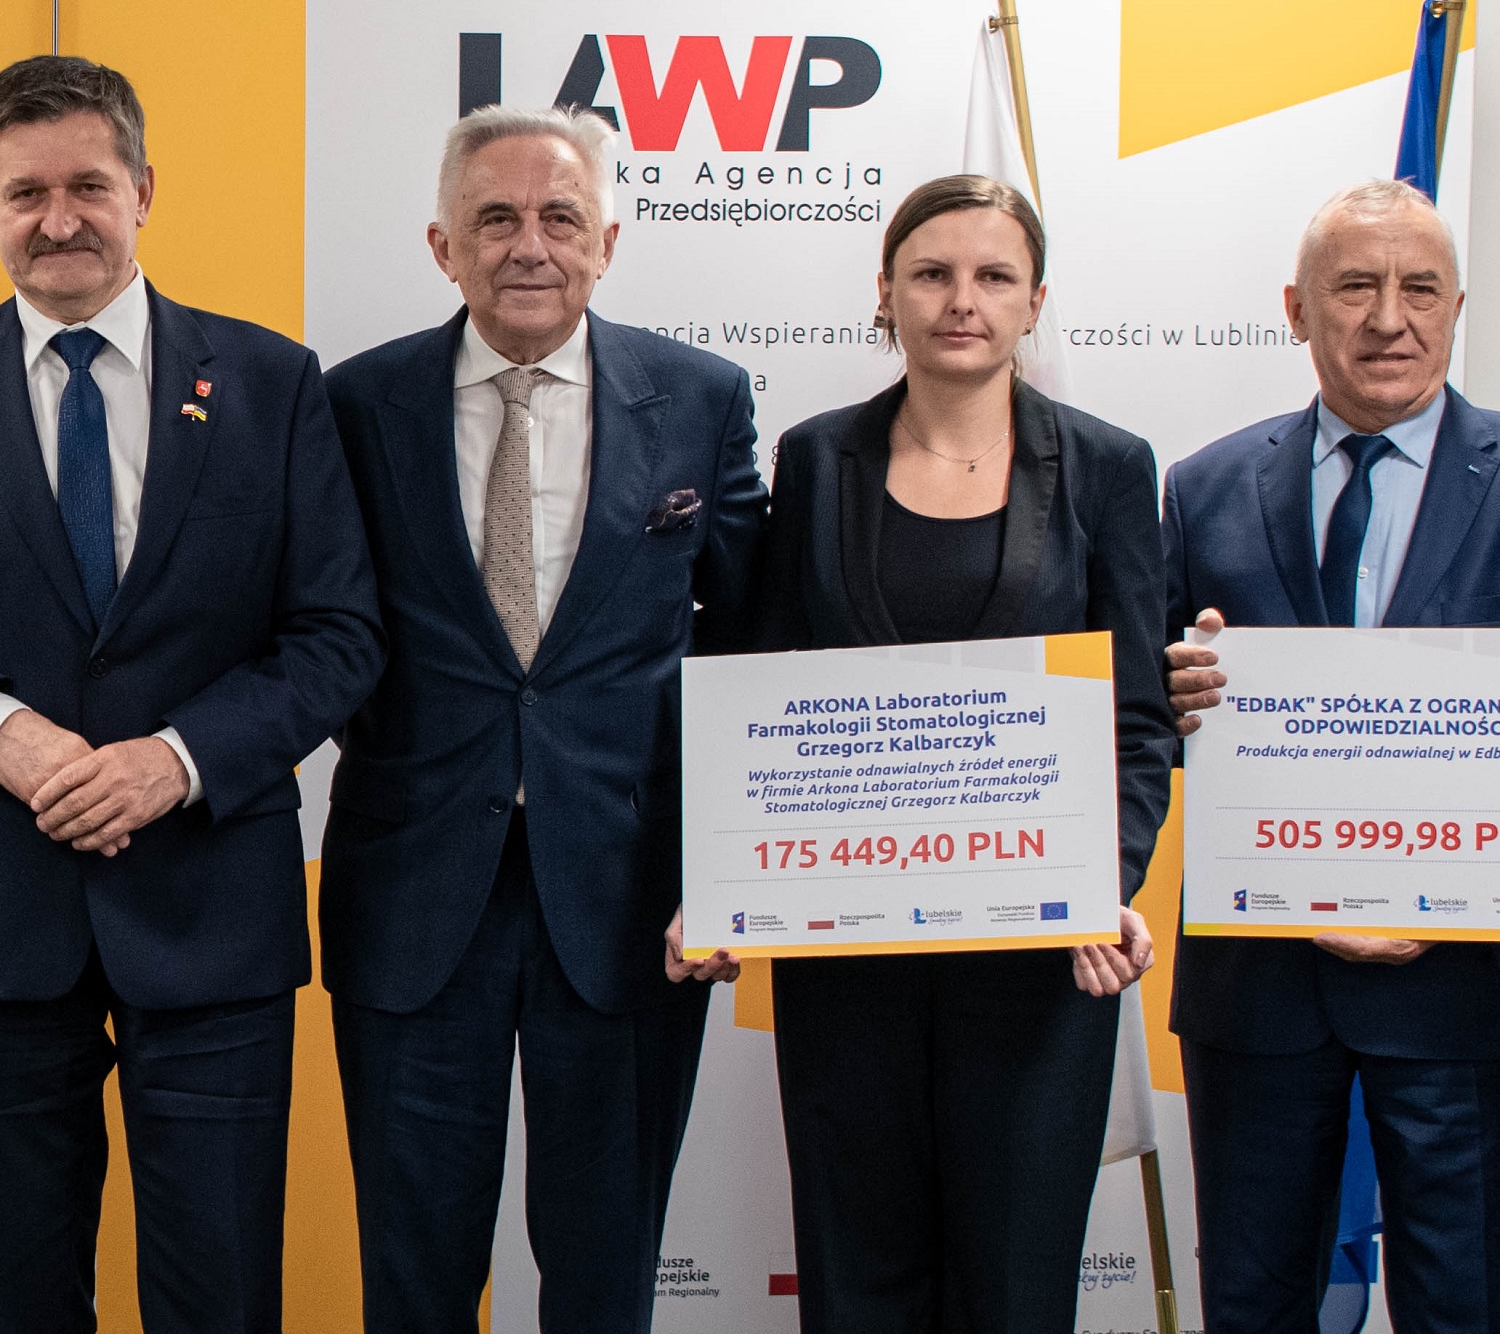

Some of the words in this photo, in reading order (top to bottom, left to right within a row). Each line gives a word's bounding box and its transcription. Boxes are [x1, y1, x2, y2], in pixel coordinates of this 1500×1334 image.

[695, 161, 882, 190] Agencja
[636, 195, 881, 226] Przedsiębiorczości
[722, 322, 878, 349] Wspierania
[784, 696, 871, 716] ARKONA
[875, 688, 1007, 711] Laboratorium
[1320, 693, 1404, 714] SPÓŁKA
[747, 716, 871, 739] Farmakologii
[876, 705, 1046, 732] Stomatologicznej
[796, 741, 884, 758] Grzegorz
[889, 730, 996, 753] Kalbarczyk
[1235, 744, 1309, 760] Produkcja
[1312, 745, 1363, 761] energii
[1365, 745, 1456, 762] odnawialnej
[748, 765, 853, 784] Wykorzystanie
[855, 759, 955, 777] odnawialnych
[957, 756, 1005, 772] źródeł
[1007, 753, 1058, 770] energii
[760, 783, 804, 801] firmie
[806, 782, 859, 796] Arkona
[862, 777, 960, 793] Laboratorium
[963, 770, 1060, 788] Farmakologii
[764, 795, 889, 814] Stomatologicznej
[890, 795, 957, 809] Grzegorz
[959, 787, 1041, 805] Kalbarczyk
[754, 839, 818, 870] 175
[830, 833, 955, 871] 449,40
[968, 828, 1045, 861] PLN
[1255, 819, 1322, 849] 505
[1334, 820, 1462, 857] 999,98
[656, 1255, 694, 1268] dusze
[1081, 1252, 1136, 1269] elskie
[668, 1287, 720, 1298] Regionalny
